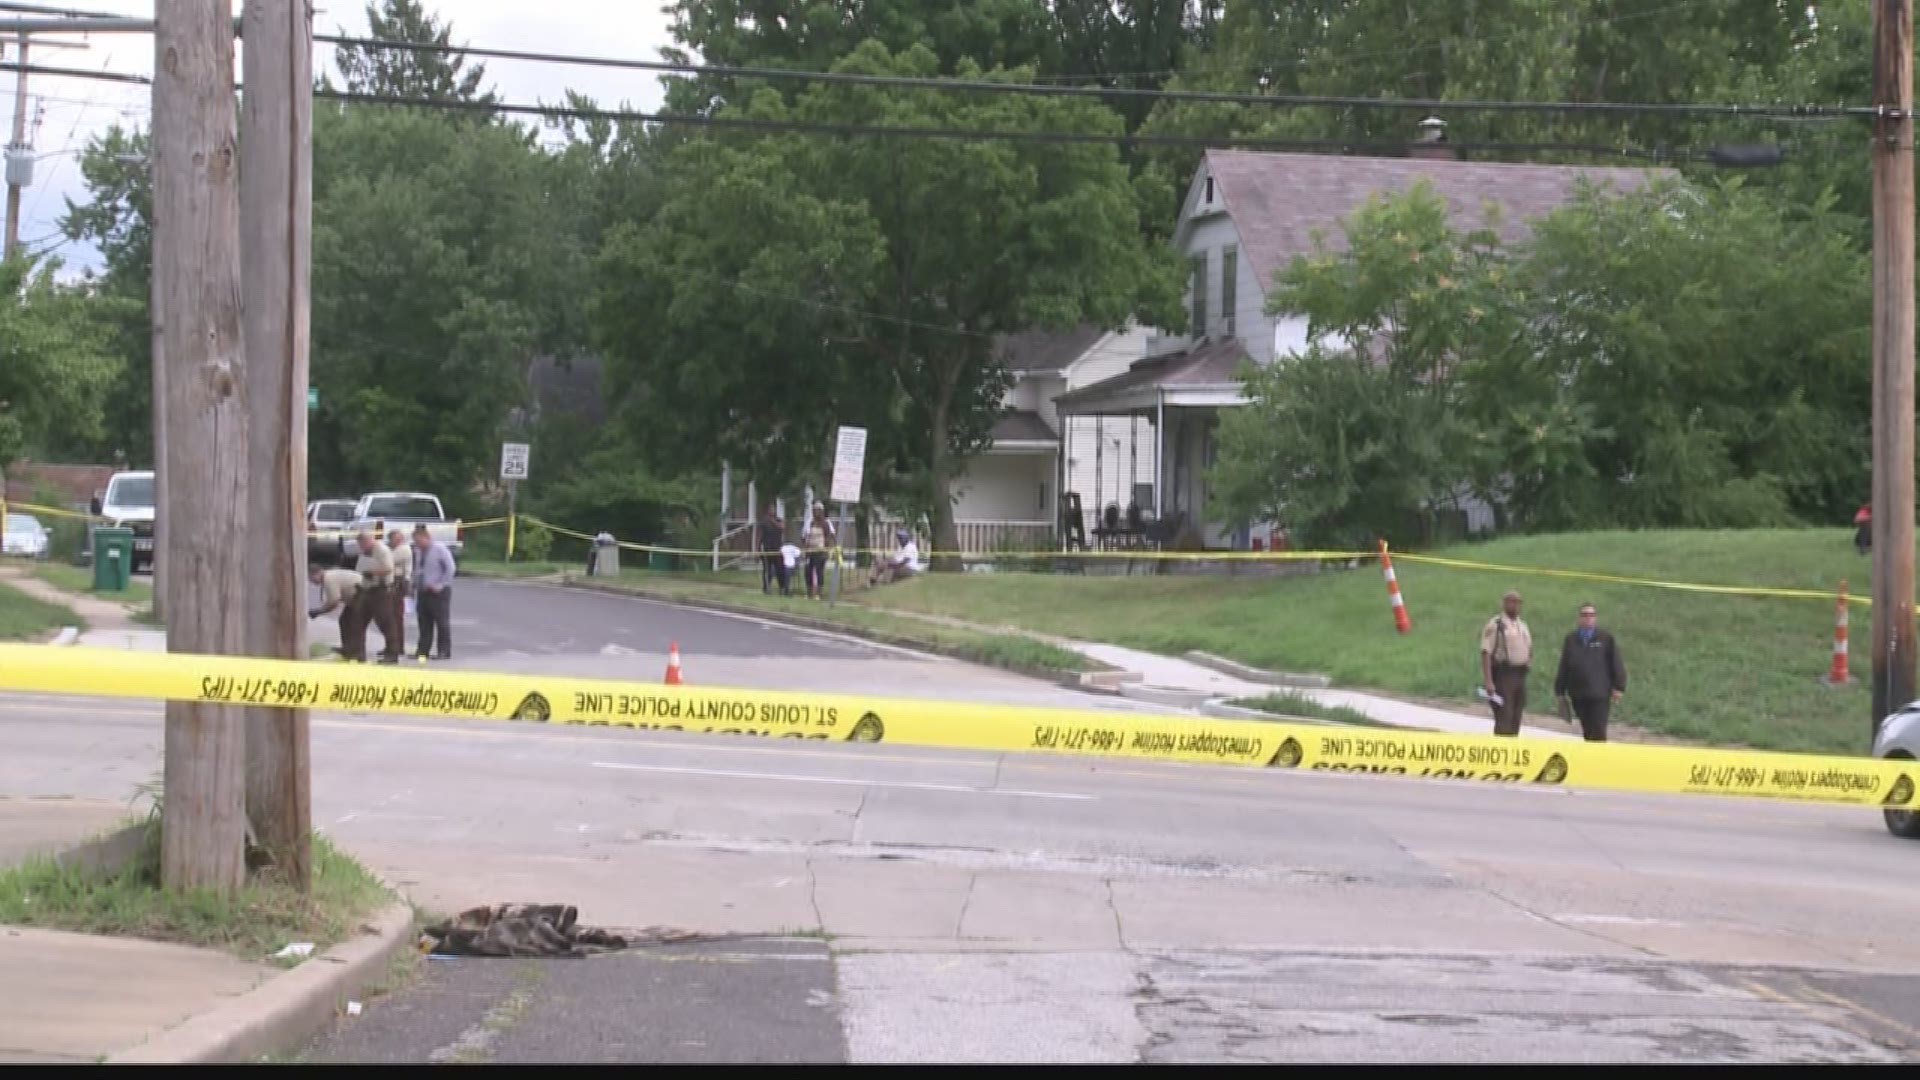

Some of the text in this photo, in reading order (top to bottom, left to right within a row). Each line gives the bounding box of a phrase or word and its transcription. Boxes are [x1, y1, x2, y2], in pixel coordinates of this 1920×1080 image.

[503, 461, 525, 475] 25
[574, 691, 838, 726] ST. LOUIS COUNTY POLICE LINE
[1320, 737, 1352, 756] LINE
[1355, 739, 1406, 760] POLICE
[1409, 743, 1466, 762] COUNTY
[1468, 745, 1508, 766] LOUIS
